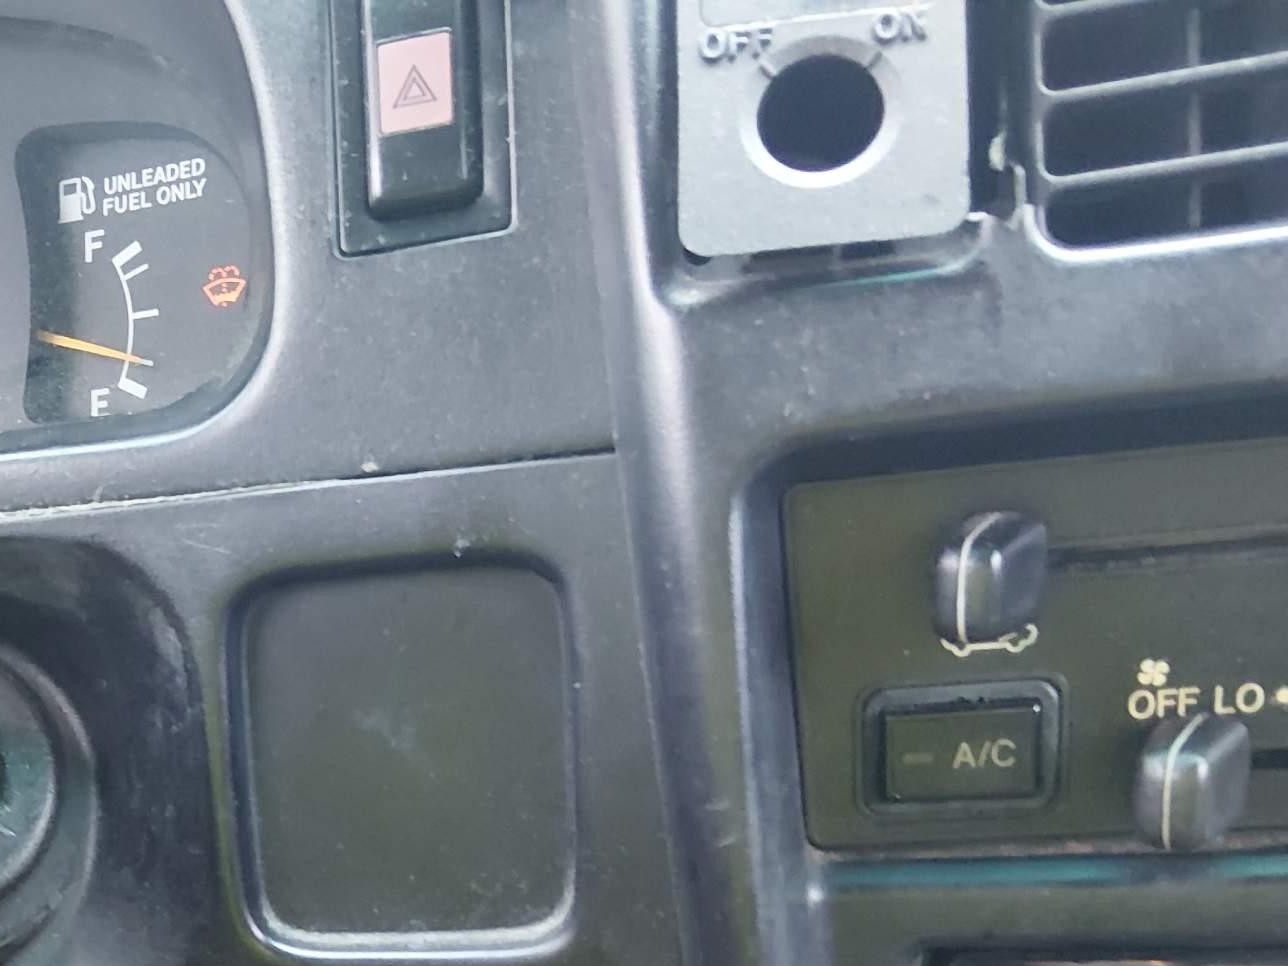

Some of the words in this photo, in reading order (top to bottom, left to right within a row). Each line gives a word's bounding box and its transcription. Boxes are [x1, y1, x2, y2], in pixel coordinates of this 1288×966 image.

[699, 28, 773, 63] OFF
[873, 12, 927, 45] ON
[103, 158, 206, 195] UNLEADED
[103, 190, 152, 217] FUEL
[156, 178, 207, 205] ONLY
[84, 229, 105, 263] F
[90, 388, 110, 417] E
[1128, 686, 1201, 720] OFF
[1215, 684, 1265, 714] LO
[952, 738, 1017, 769] A/C
